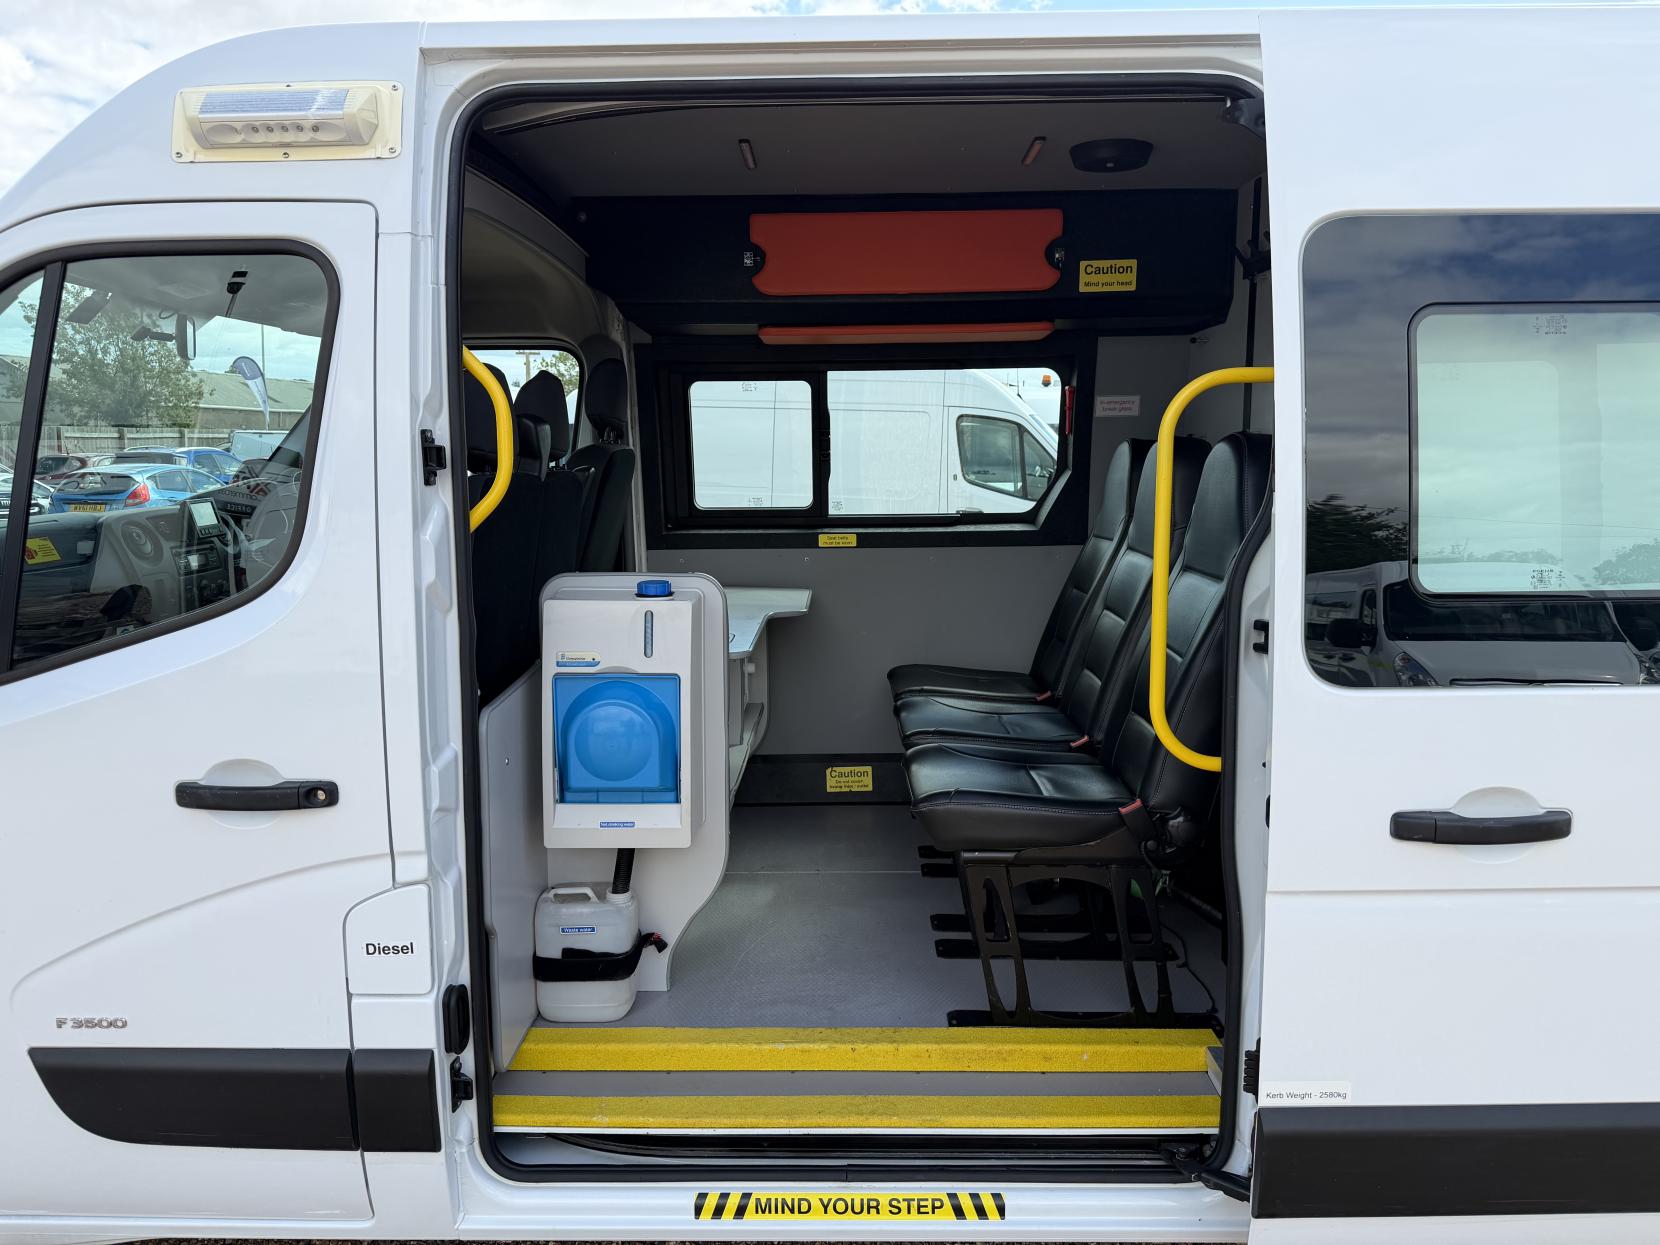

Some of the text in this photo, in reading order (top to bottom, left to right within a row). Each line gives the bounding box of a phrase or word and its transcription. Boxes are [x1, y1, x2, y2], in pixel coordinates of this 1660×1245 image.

[1084, 264, 1133, 275] Caution
[830, 769, 869, 778] Caution
[365, 941, 414, 955] Diesel
[56, 1017, 128, 1029] F 3500
[1286, 1092, 1312, 1100] Weight
[1320, 1091, 1347, 1099] 2580kg
[754, 1197, 945, 1214] MIND YOUR STEP
